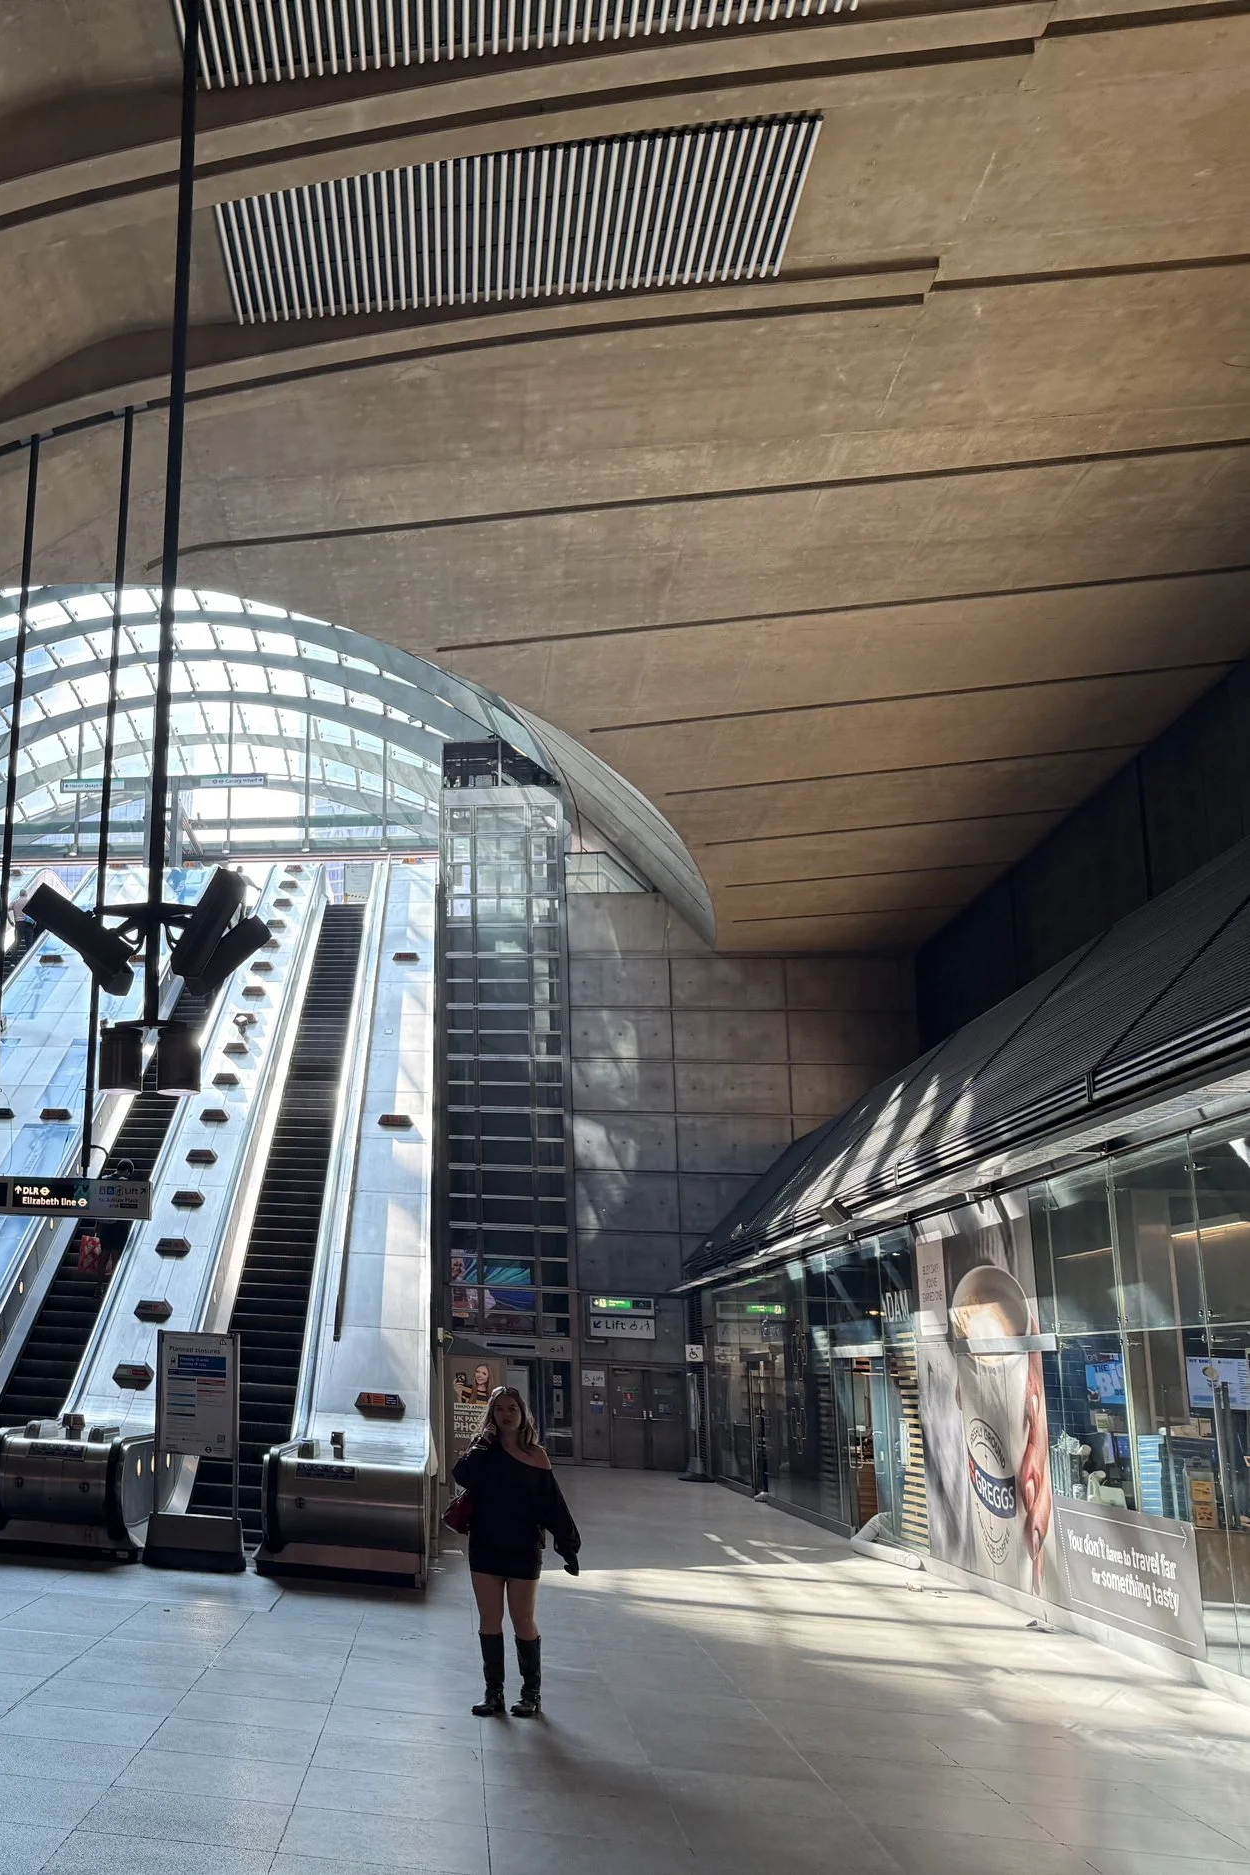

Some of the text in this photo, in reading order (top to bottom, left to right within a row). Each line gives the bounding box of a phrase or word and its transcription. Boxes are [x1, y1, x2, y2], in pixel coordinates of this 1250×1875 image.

[23, 1186, 39, 1195] DLR
[125, 1187, 138, 1195] Lift
[22, 1196, 77, 1206] Elizabeth line
[605, 1320, 626, 1330] Lift
[169, 1345, 194, 1353] Planned
[1093, 1364, 1110, 1373] THE
[984, 1428, 1006, 1469] GROUND
[975, 1469, 1015, 1511] GREGGS
[1067, 1528, 1177, 1581] You don't have to travel far
[1091, 1568, 1180, 1617] for something tasty
